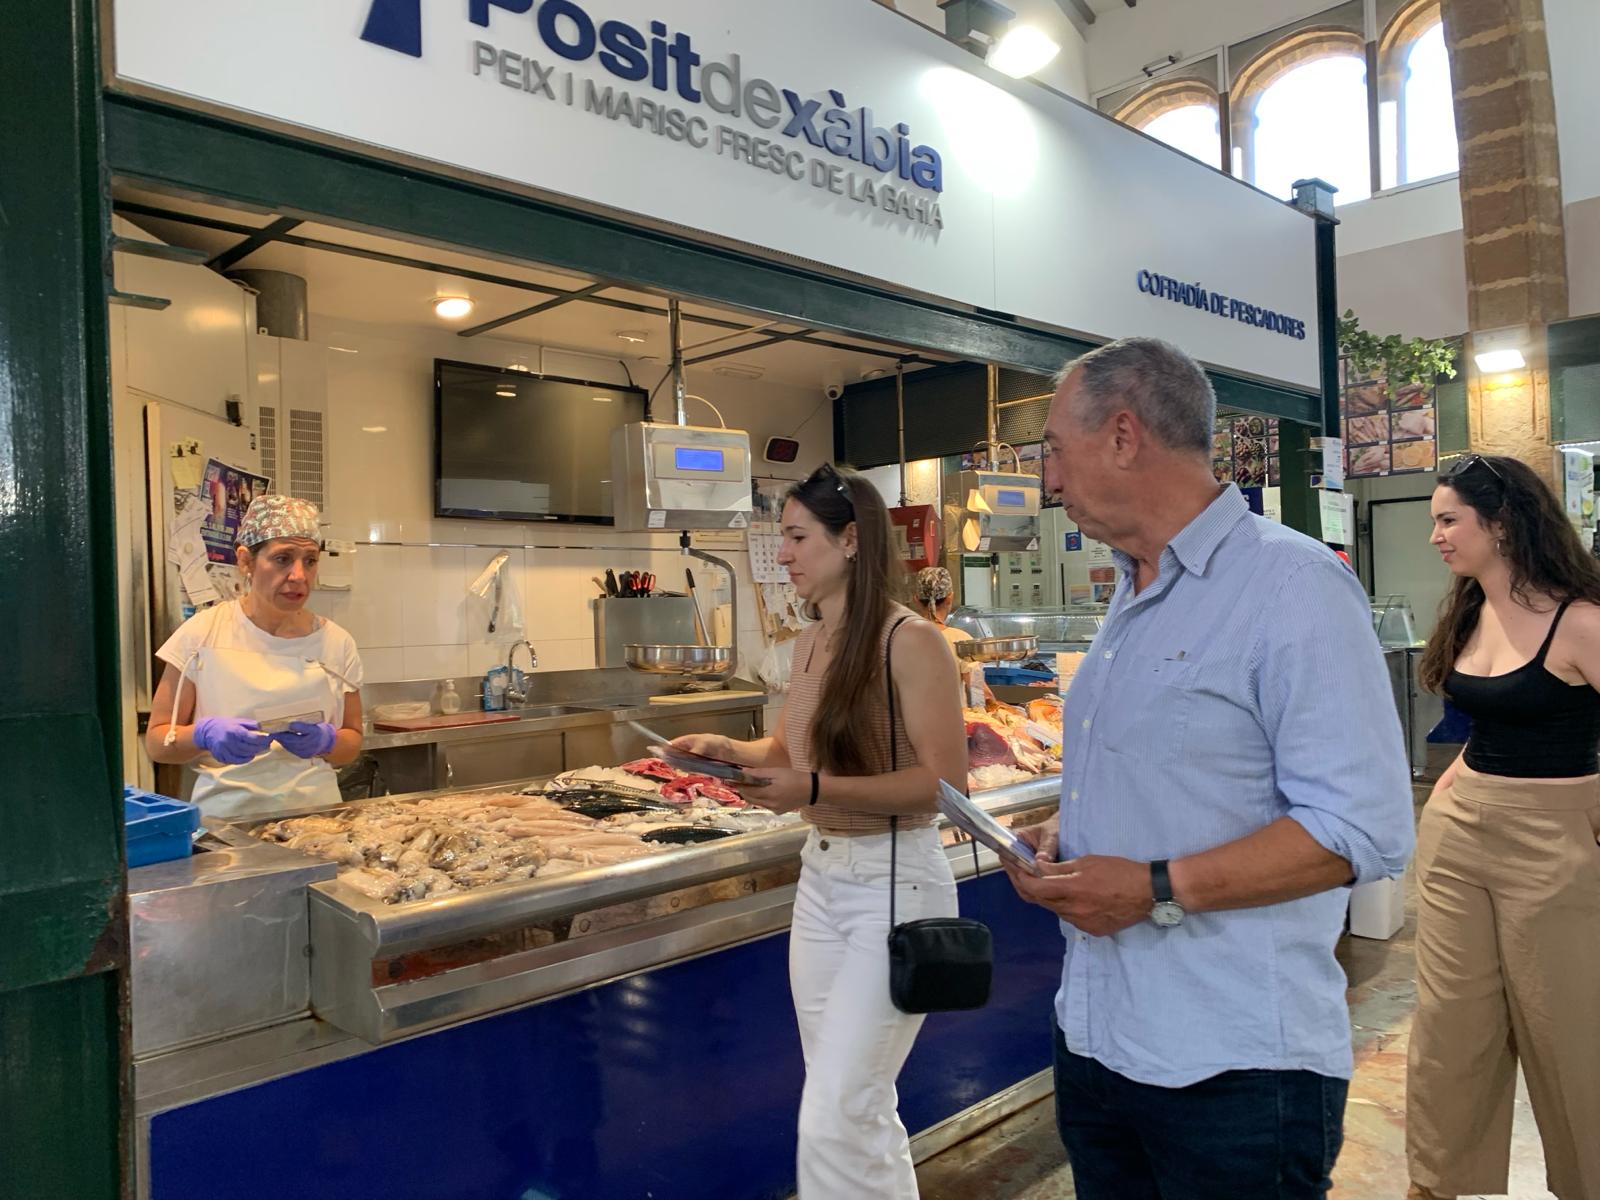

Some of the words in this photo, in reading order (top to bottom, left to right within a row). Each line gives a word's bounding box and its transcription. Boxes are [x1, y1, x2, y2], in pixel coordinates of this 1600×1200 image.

[472, 40, 556, 101] PEIX
[565, 72, 573, 106] I
[584, 78, 708, 149] MARISC
[715, 125, 805, 181] FRESC
[810, 158, 844, 195] DE
[848, 172, 878, 208] LA
[1137, 269, 1209, 311] COFRADÍA
[1210, 292, 1229, 317] DE
[1230, 299, 1306, 340] PESCADORES
